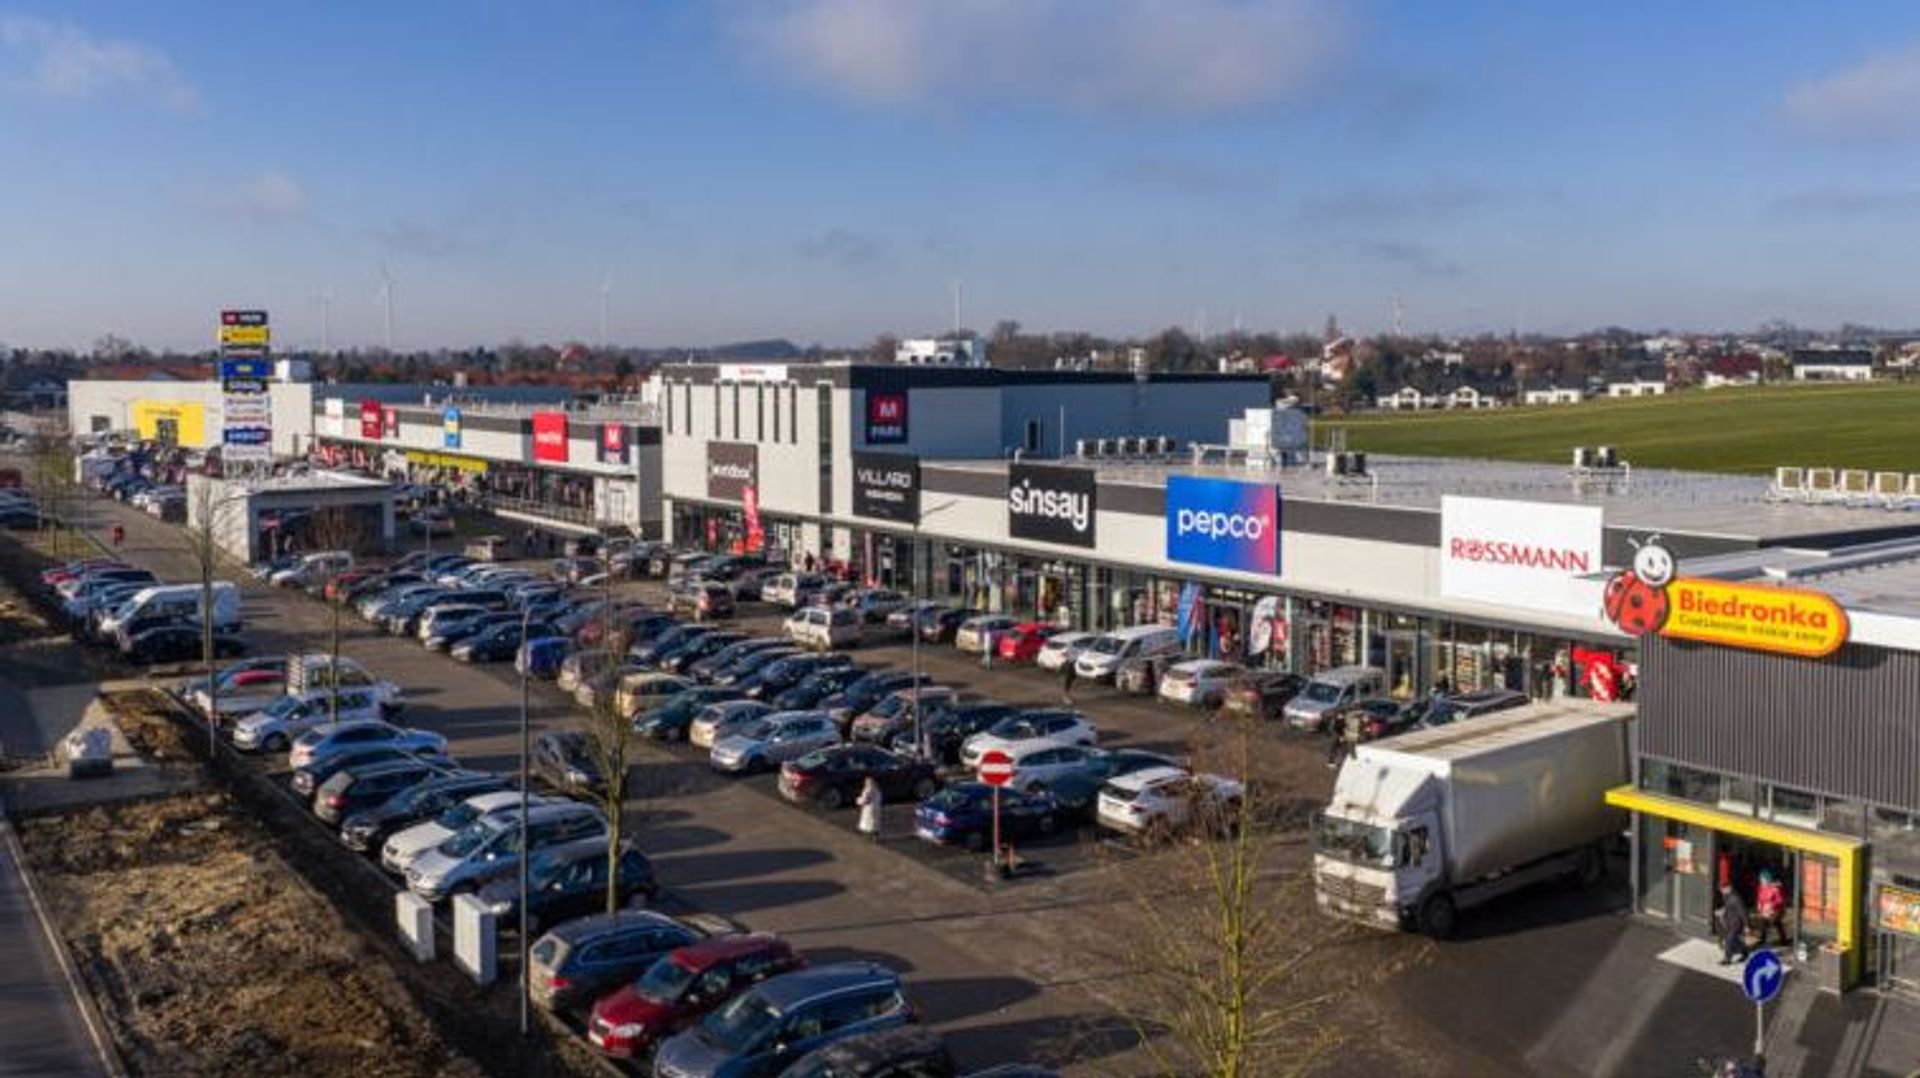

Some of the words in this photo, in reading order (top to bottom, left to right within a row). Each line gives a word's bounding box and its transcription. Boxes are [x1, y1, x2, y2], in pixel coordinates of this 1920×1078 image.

[880, 401, 897, 418] M
[1010, 478, 1089, 532] sinsay
[1451, 537, 1589, 571] ROSSMANN
[1679, 588, 1828, 629] Biedronka
